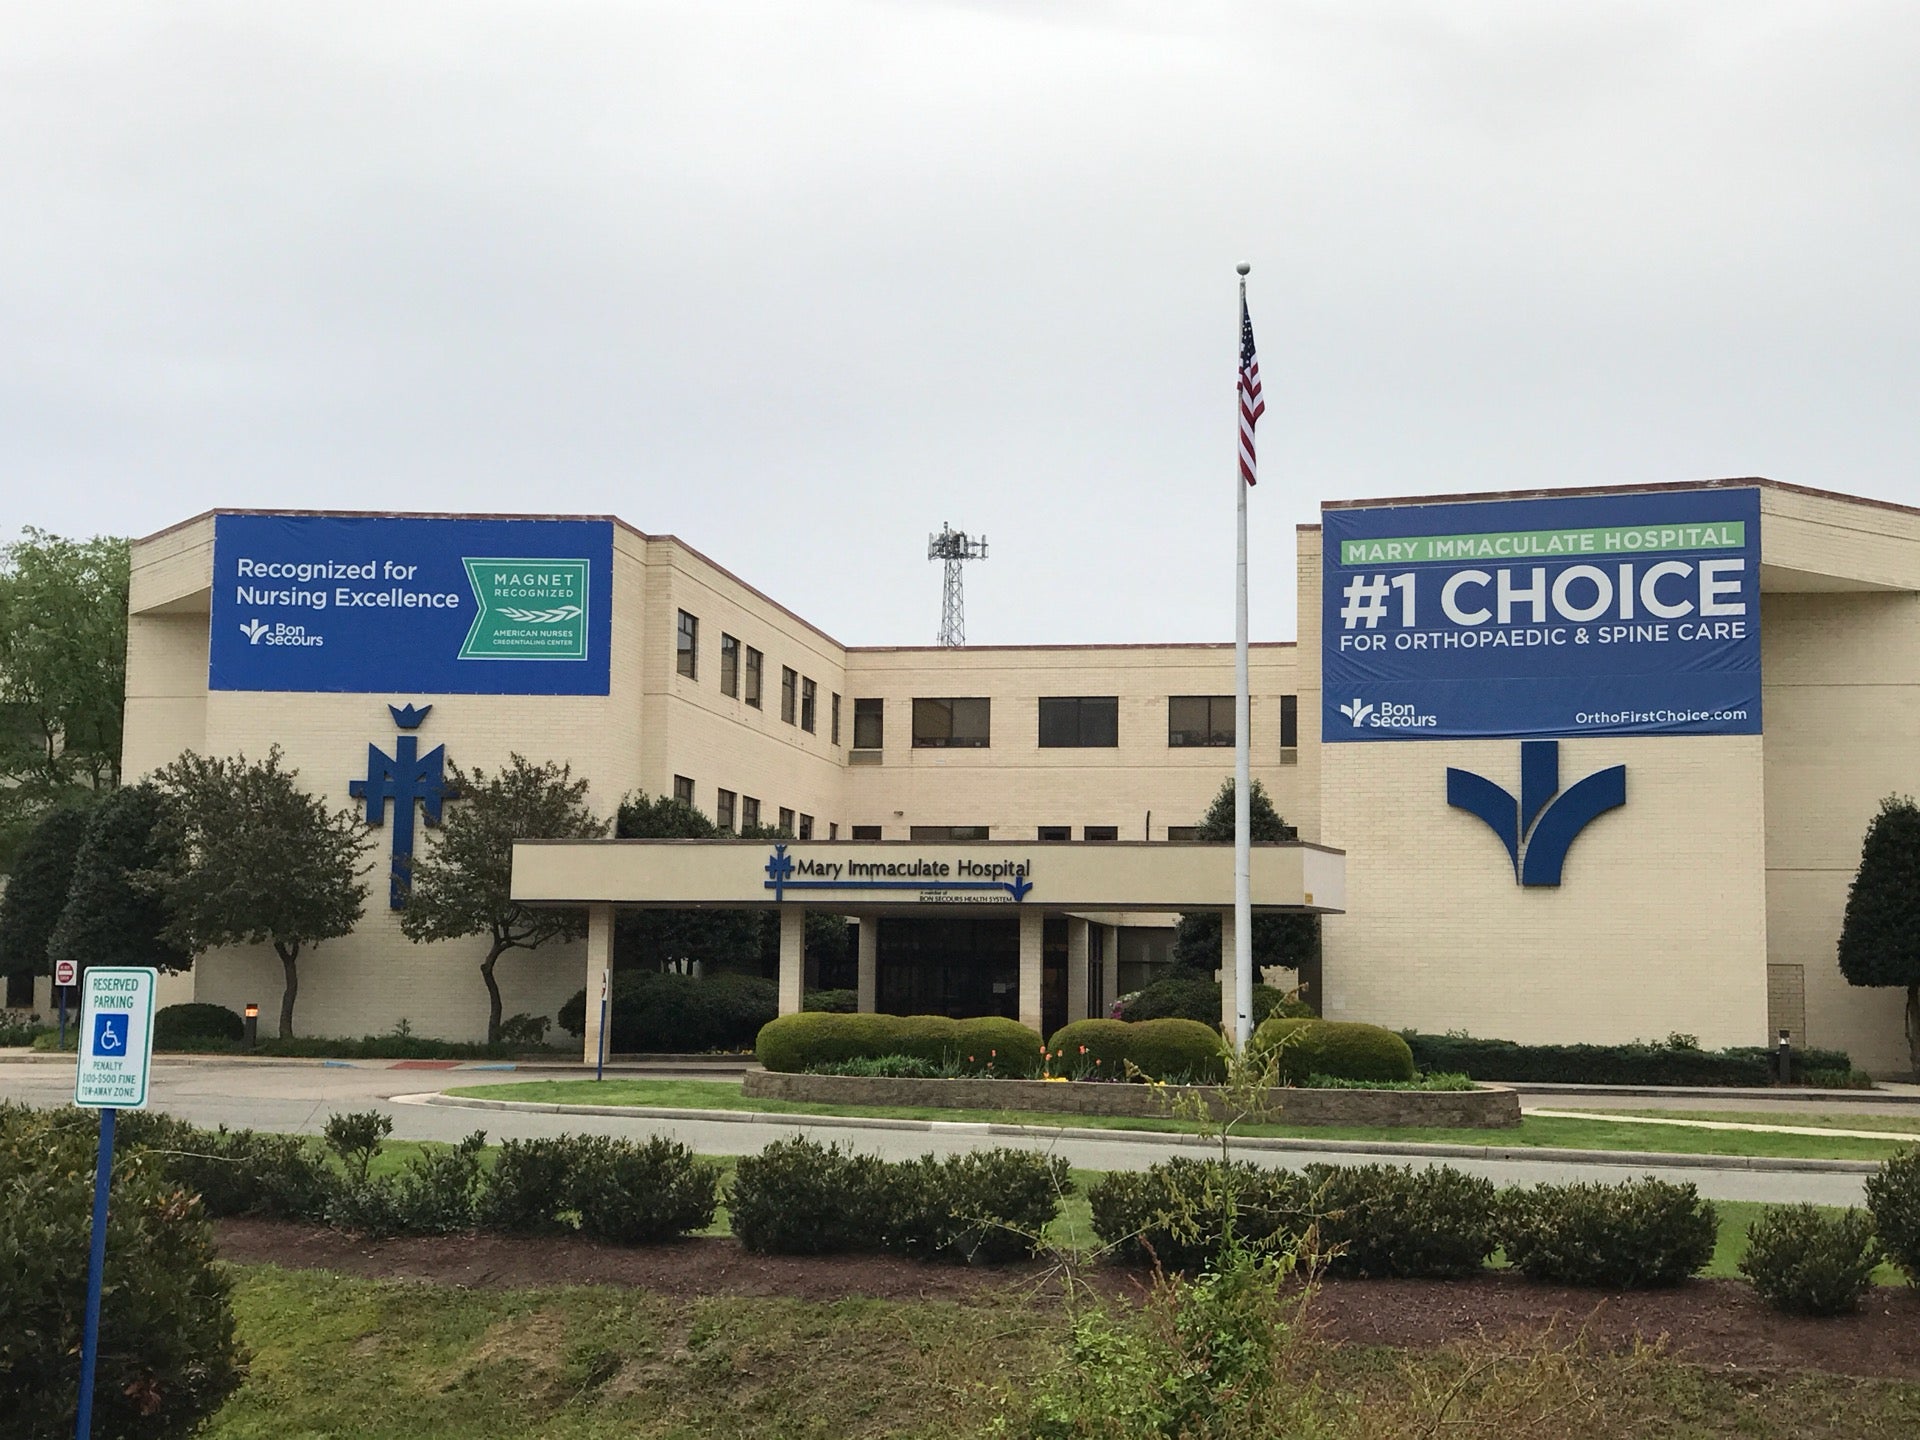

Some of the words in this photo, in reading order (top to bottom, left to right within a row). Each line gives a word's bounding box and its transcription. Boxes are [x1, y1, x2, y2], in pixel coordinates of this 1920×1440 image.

[1349, 541, 1418, 561] MARY
[1428, 533, 1595, 558] IMMACULATE
[1605, 526, 1736, 550] HOSPITAL
[237, 558, 377, 582] Recognized
[384, 560, 417, 580] for
[494, 573, 574, 586] MAGNET
[236, 586, 327, 610] Nursing
[335, 588, 460, 609] Excellence
[494, 588, 574, 598] RECOGNIZED
[1340, 572, 1416, 630] #1
[1441, 558, 1746, 626] CHOICE
[275, 622, 305, 636] Bon
[265, 633, 324, 646] Secours
[1340, 634, 1387, 652] FOR
[1394, 628, 1567, 651] ORTHOPAEDIC
[1574, 628, 1590, 645] &
[1598, 624, 1670, 644] SPINE
[1677, 622, 1746, 641] CARE
[1381, 702, 1416, 716] Bon
[1575, 708, 1748, 724] OrthoFirstChoice.com
[1370, 713, 1437, 728] Secours
[797, 859, 843, 880] Mary
[849, 858, 950, 877] Immaculate
[958, 859, 1031, 881] Hospital
[93, 978, 139, 992] RESERVED
[93, 996, 134, 1009] PARKING
[92, 1061, 123, 1070] PENALTY
[118, 1074, 136, 1084] FINE
[113, 1088, 135, 1098] ZONE
